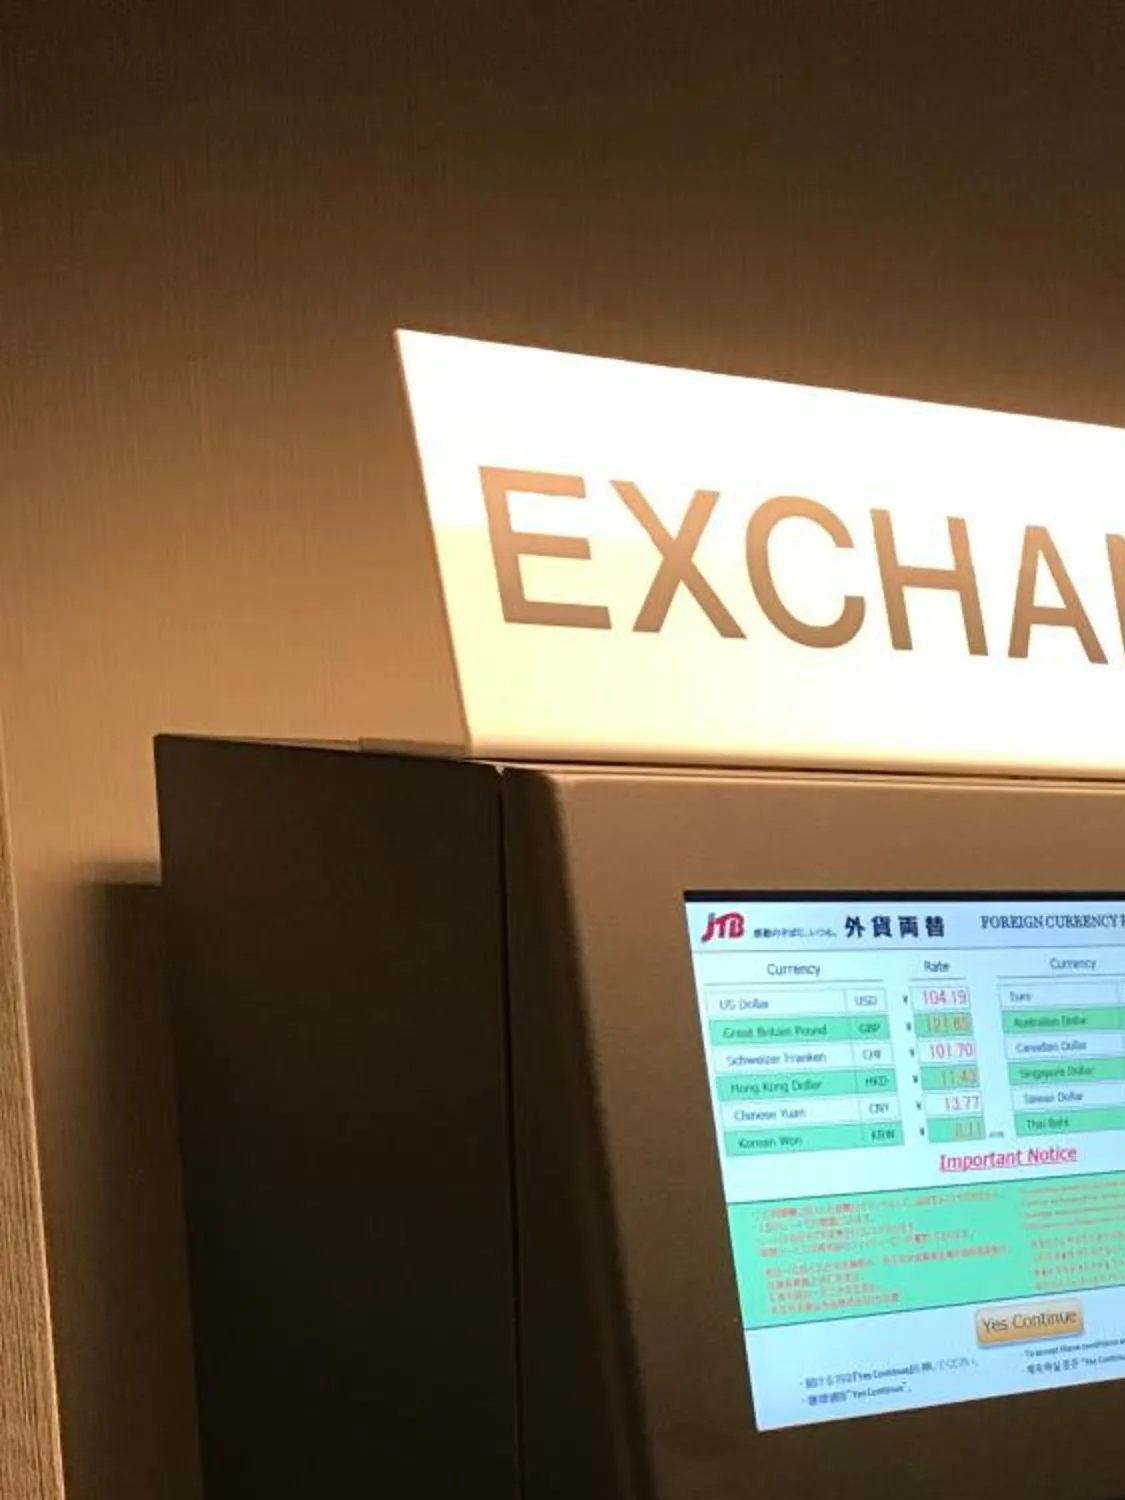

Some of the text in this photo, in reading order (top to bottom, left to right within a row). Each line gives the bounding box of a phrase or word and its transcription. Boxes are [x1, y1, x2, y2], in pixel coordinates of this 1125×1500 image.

[844, 914, 945, 939] 外貨両替
[981, 915, 1044, 930] FOREIGN
[1045, 914, 1119, 929] CURRENCY
[766, 962, 821, 977] Currency
[924, 960, 950, 972] Rate
[1049, 957, 1097, 971] Currency
[940, 1146, 1077, 1172] Important Notice
[983, 1310, 1077, 1333] Yes Continue
